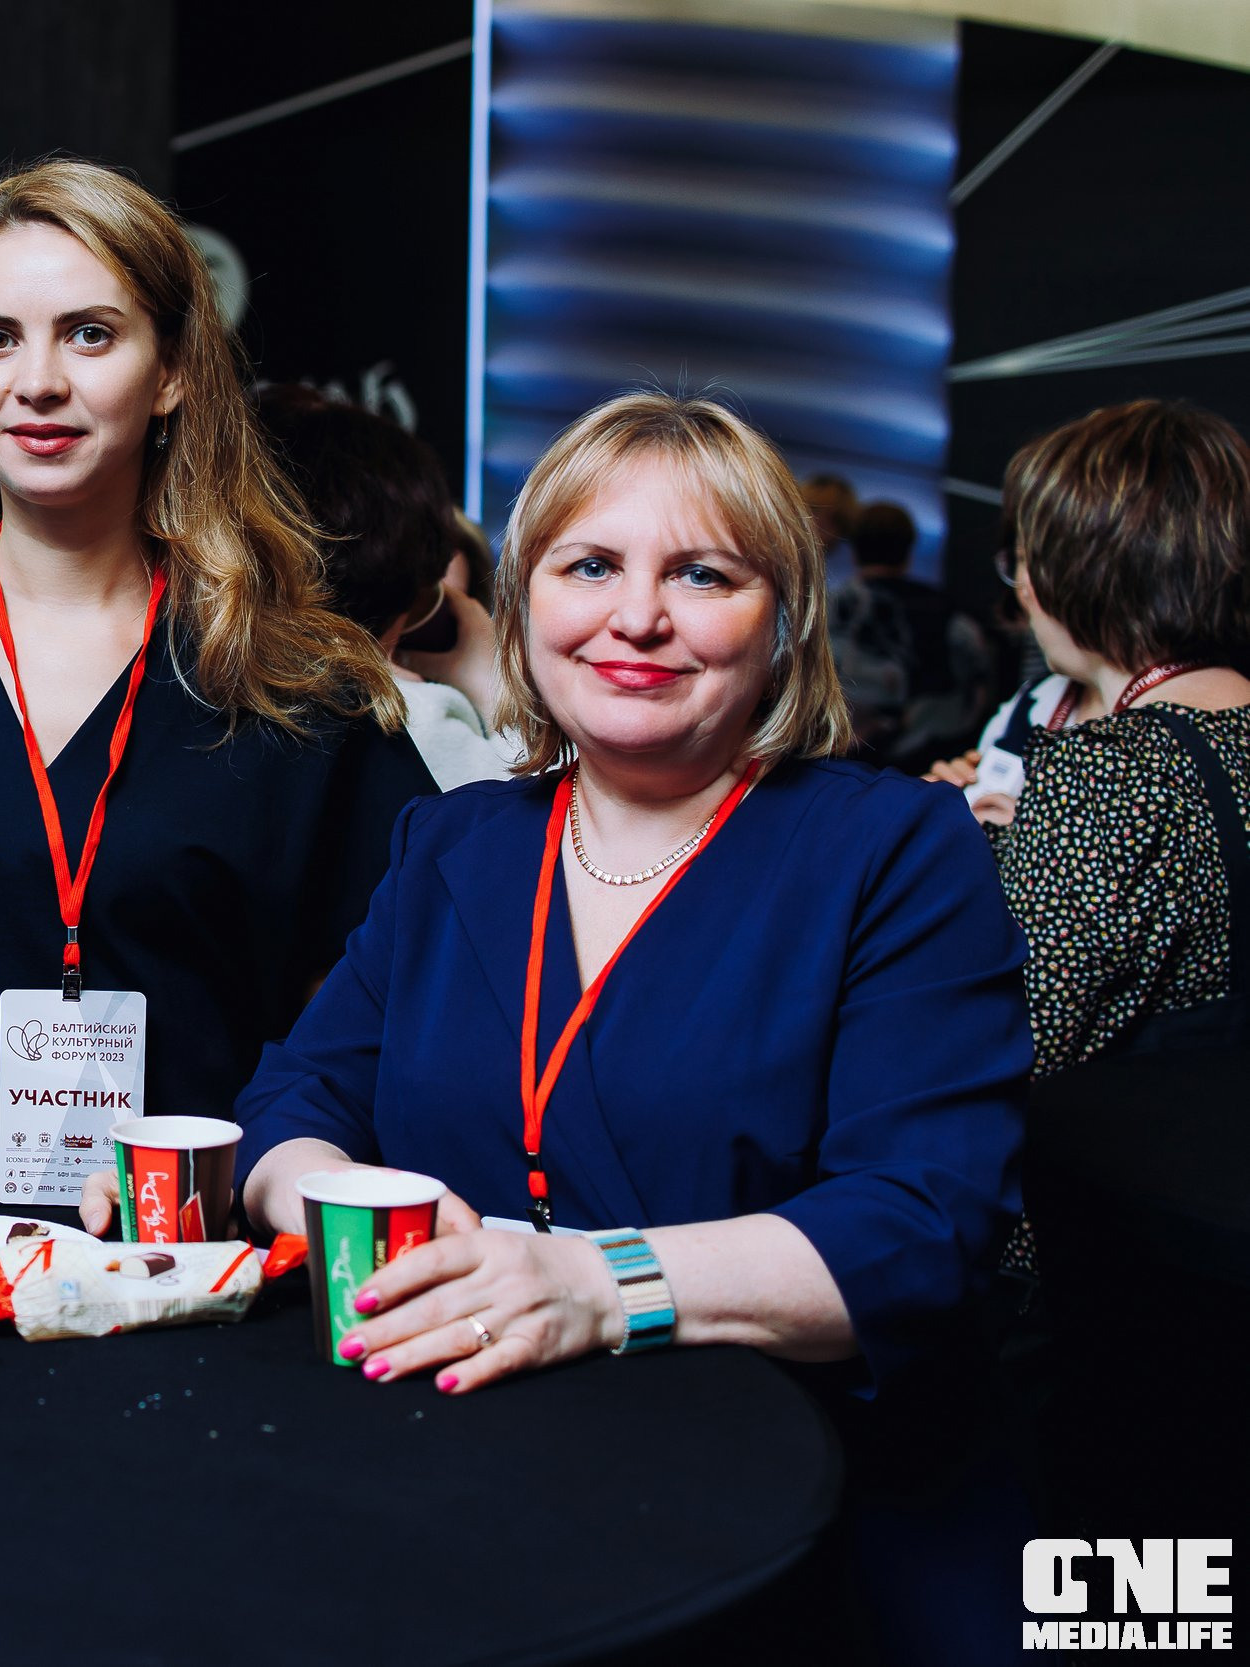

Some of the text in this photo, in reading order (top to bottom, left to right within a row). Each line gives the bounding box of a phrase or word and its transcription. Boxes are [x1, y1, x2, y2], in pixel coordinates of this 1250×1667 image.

[52, 1022, 137, 1035] БАЛТИЙСКИЙ
[52, 1037, 133, 1048] КУЛЬТУРНЫЙ
[51, 1051, 125, 1062] ФОРУМ 2023
[9, 1089, 132, 1108] УЧАСТНИК
[140, 1171, 170, 1215] Day
